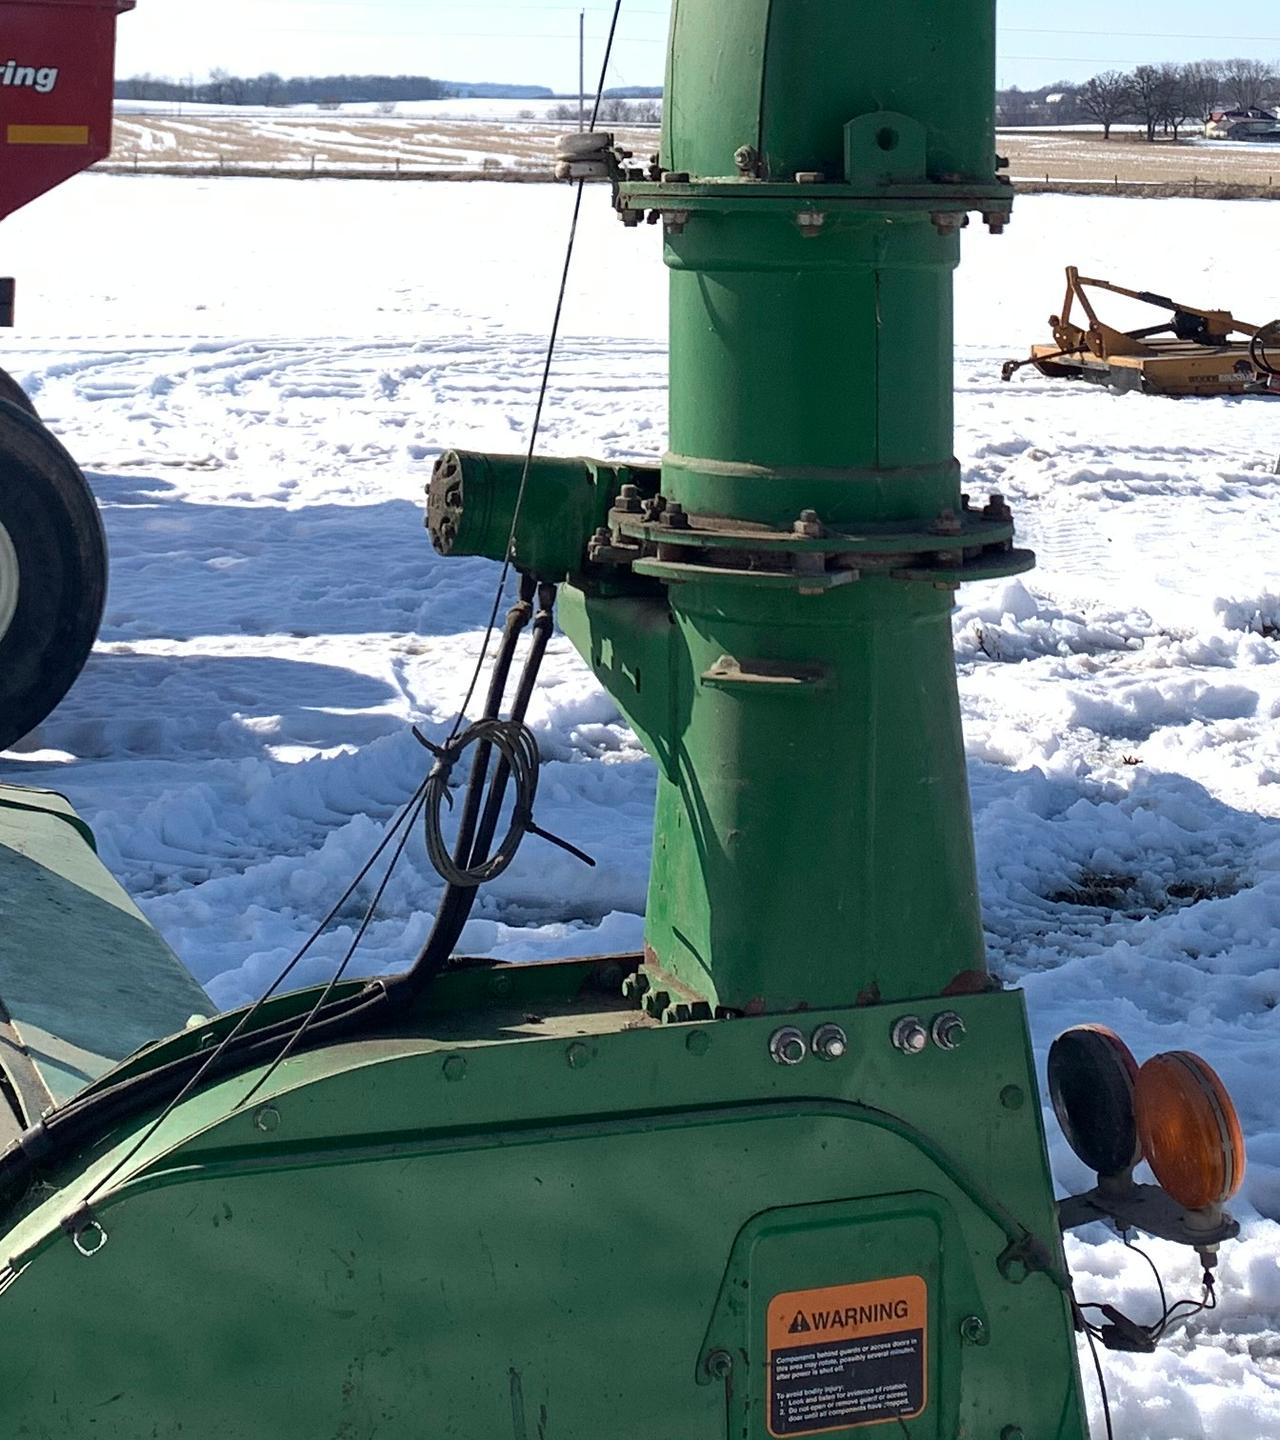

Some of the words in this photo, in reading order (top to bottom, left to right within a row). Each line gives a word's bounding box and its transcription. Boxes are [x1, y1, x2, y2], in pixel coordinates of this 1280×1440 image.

[812, 1300, 909, 1331] WARNING
[776, 1353, 816, 1364] Components
[816, 1350, 838, 1359] behind
[870, 1342, 891, 1351] access
[892, 1340, 910, 1348] doors
[789, 1363, 803, 1371] area
[804, 1361, 818, 1369] may
[839, 1354, 866, 1365] possibly
[867, 1350, 889, 1360] several
[776, 1373, 791, 1381] after
[791, 1370, 811, 1380] power
[819, 1366, 834, 1375] shut
[776, 1392, 785, 1400] To
[786, 1390, 803, 1399] avoid
[788, 1398, 804, 1406] Look
[805, 1396, 818, 1404] and
[846, 1388, 874, 1398] evidence
[788, 1406, 798, 1415] Do
[799, 1405, 810, 1413] not
[810, 1403, 827, 1412] open
[827, 1401, 835, 1409] or
[835, 1398, 859, 1408] remove
[859, 1395, 878, 1405] guard
[878, 1393, 886, 1401] or
[886, 1391, 908, 1400] access
[788, 1414, 803, 1423] door
[803, 1411, 819, 1420] until
[828, 1405, 867, 1417] components
[867, 1402, 882, 1410] have
